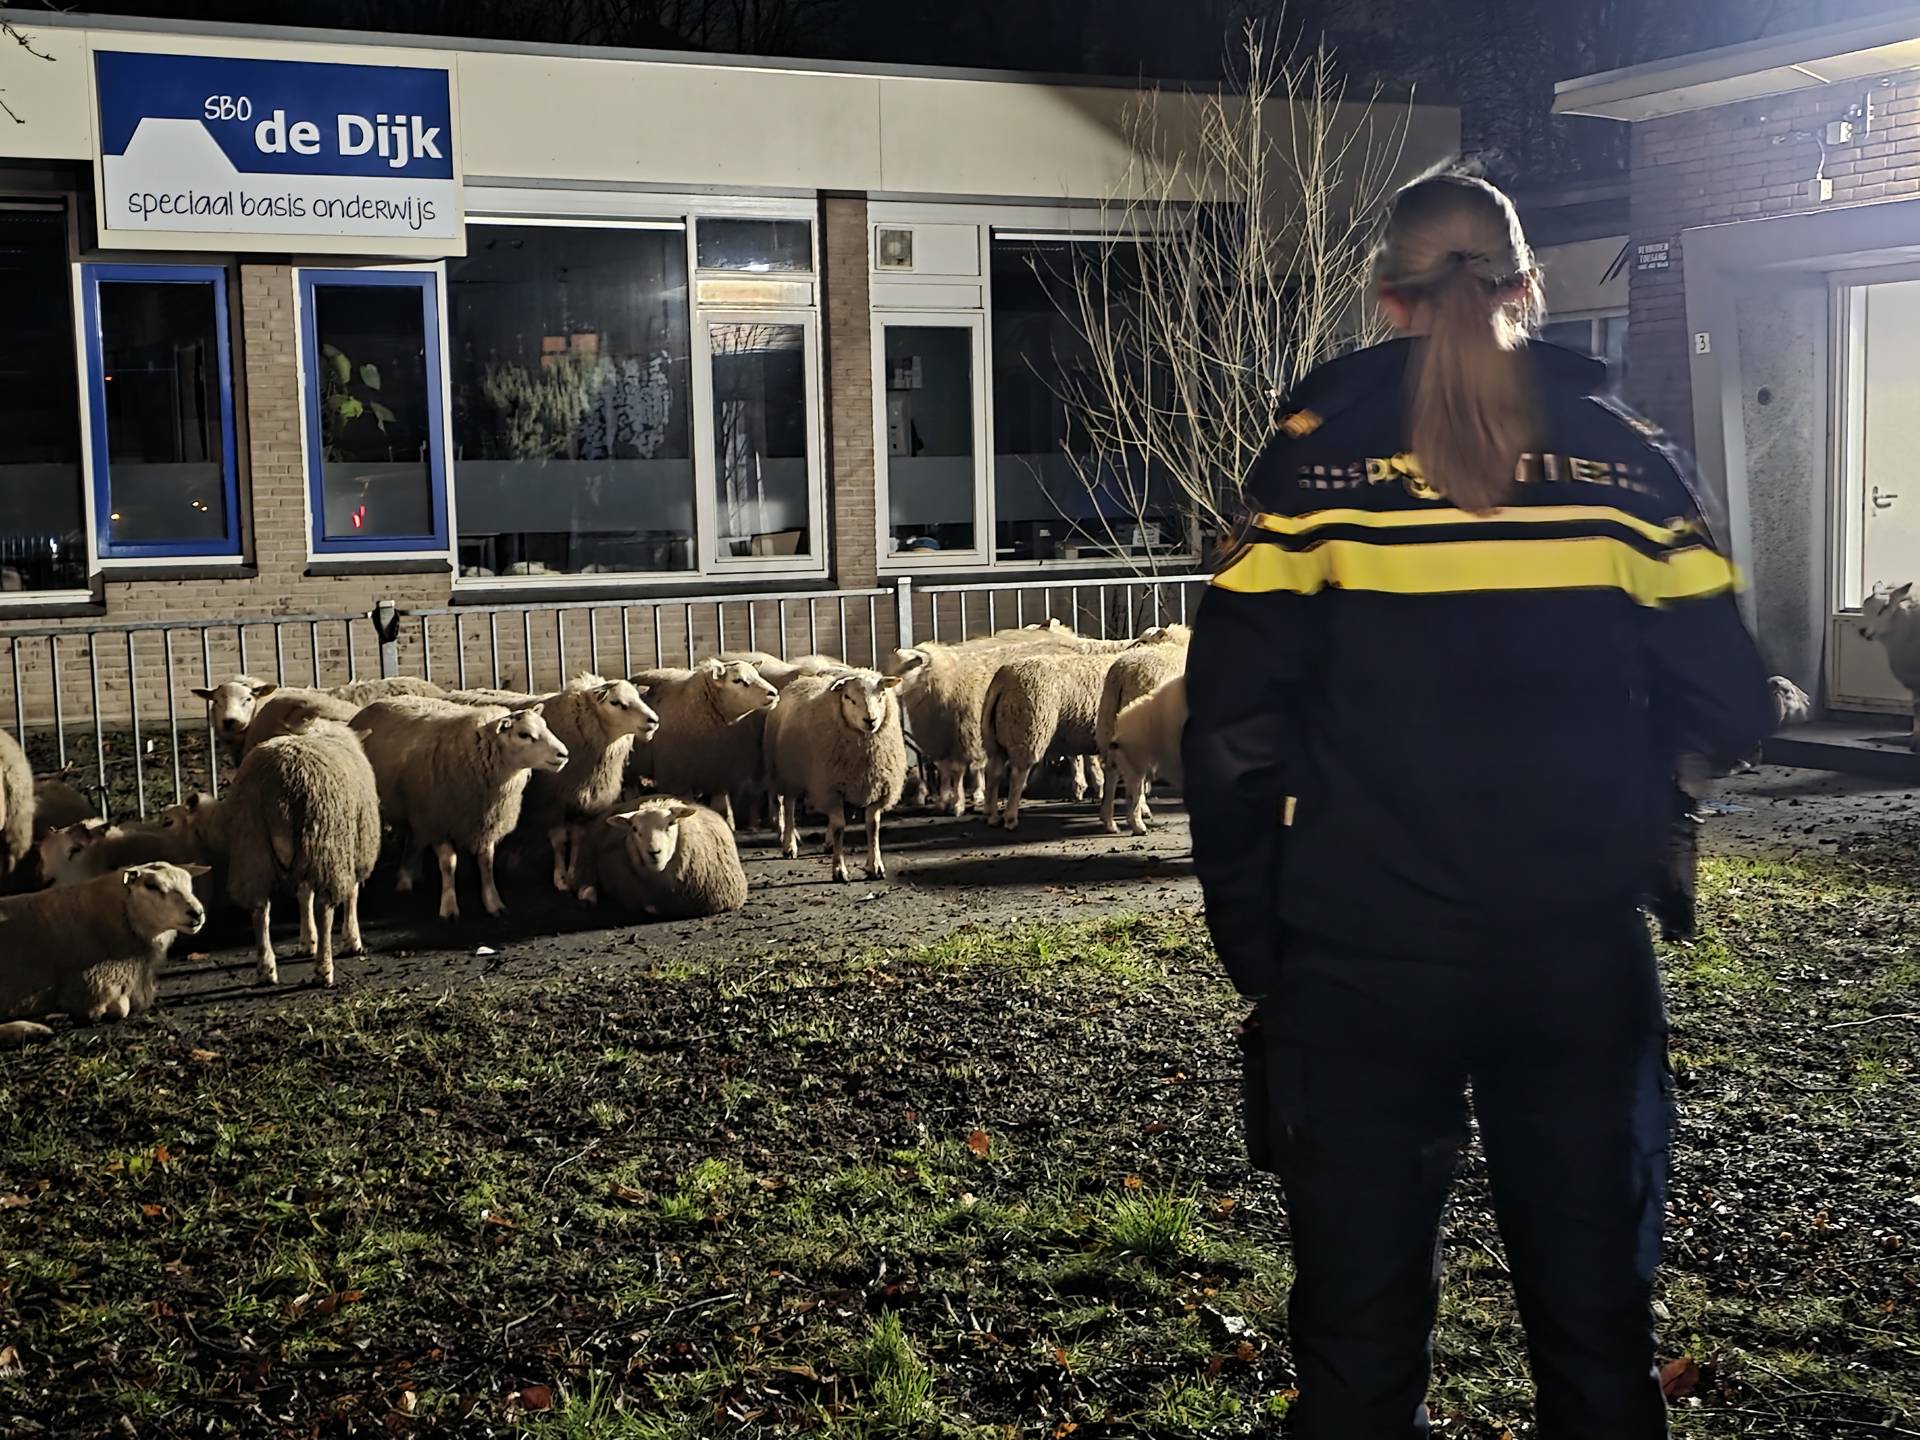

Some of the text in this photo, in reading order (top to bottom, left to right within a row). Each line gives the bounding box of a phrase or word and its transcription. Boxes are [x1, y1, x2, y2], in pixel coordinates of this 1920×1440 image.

[204, 95, 252, 121] SBO
[254, 110, 443, 168] de Dijk
[128, 190, 436, 230] speciaal basis onderwijs
[1699, 335, 1706, 350] 3
